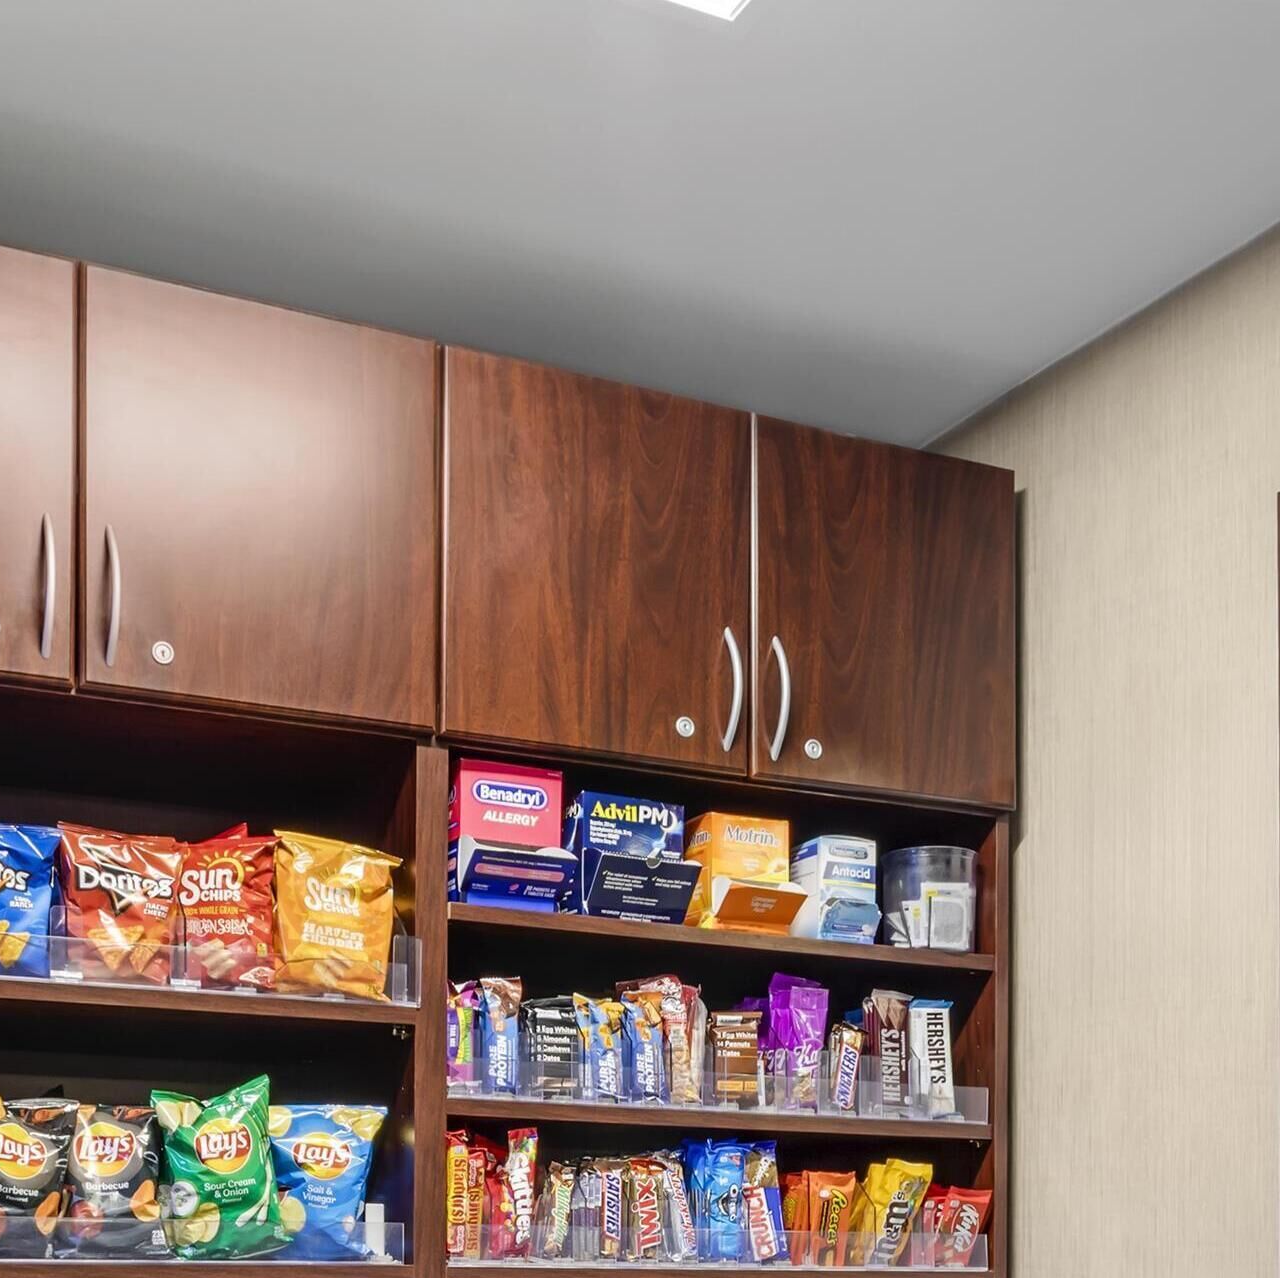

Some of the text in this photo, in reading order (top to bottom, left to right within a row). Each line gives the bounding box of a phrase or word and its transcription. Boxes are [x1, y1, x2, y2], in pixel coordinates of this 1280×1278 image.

[479, 784, 540, 809] Benadryl
[483, 809, 539, 827] ALLERGY
[591, 800, 669, 827] Advil PM
[725, 824, 777, 848] Motrin
[78, 864, 173, 898] Doritos
[832, 863, 871, 880] Antacid
[179, 868, 242, 906] Sun
[200, 889, 242, 902] CHIPS
[304, 876, 361, 912] Sun
[9, 899, 34, 910] RANCH
[301, 933, 364, 950] CHEDDAR
[303, 921, 364, 941] HARVEST
[542, 1025, 577, 1035] Egg Whites
[543, 1035, 571, 1044] Almonds
[722, 1031, 757, 1039] Egg Whites
[543, 1044, 571, 1053] Cashews
[725, 1040, 751, 1048] Peanuts
[926, 1011, 947, 1085] HERSHEY'S
[489, 1045, 497, 1077] PURE
[496, 1034, 507, 1087] PROTEIN
[542, 1054, 561, 1062] Dates
[637, 1053, 646, 1085] PURE
[645, 1043, 654, 1093] PROTEIN
[881, 1028, 901, 1101] HERSHEY'S
[835, 1046, 858, 1109] SNICKERS
[80, 1134, 136, 1162] Lay's
[198, 1128, 249, 1161] Lay's
[299, 1144, 350, 1169] Lay's
[85, 1181, 130, 1192] Barbecue
[204, 1176, 257, 1192] Sour Cream
[214, 1186, 249, 1198] & Onion
[307, 1183, 334, 1195] Salt &
[302, 1192, 337, 1206] Vinegar
[508, 1152, 533, 1245] Skittles
[605, 1174, 621, 1239] SATISFIES
[742, 1185, 774, 1259] CRUNCH
[827, 1188, 848, 1248] Reese's
